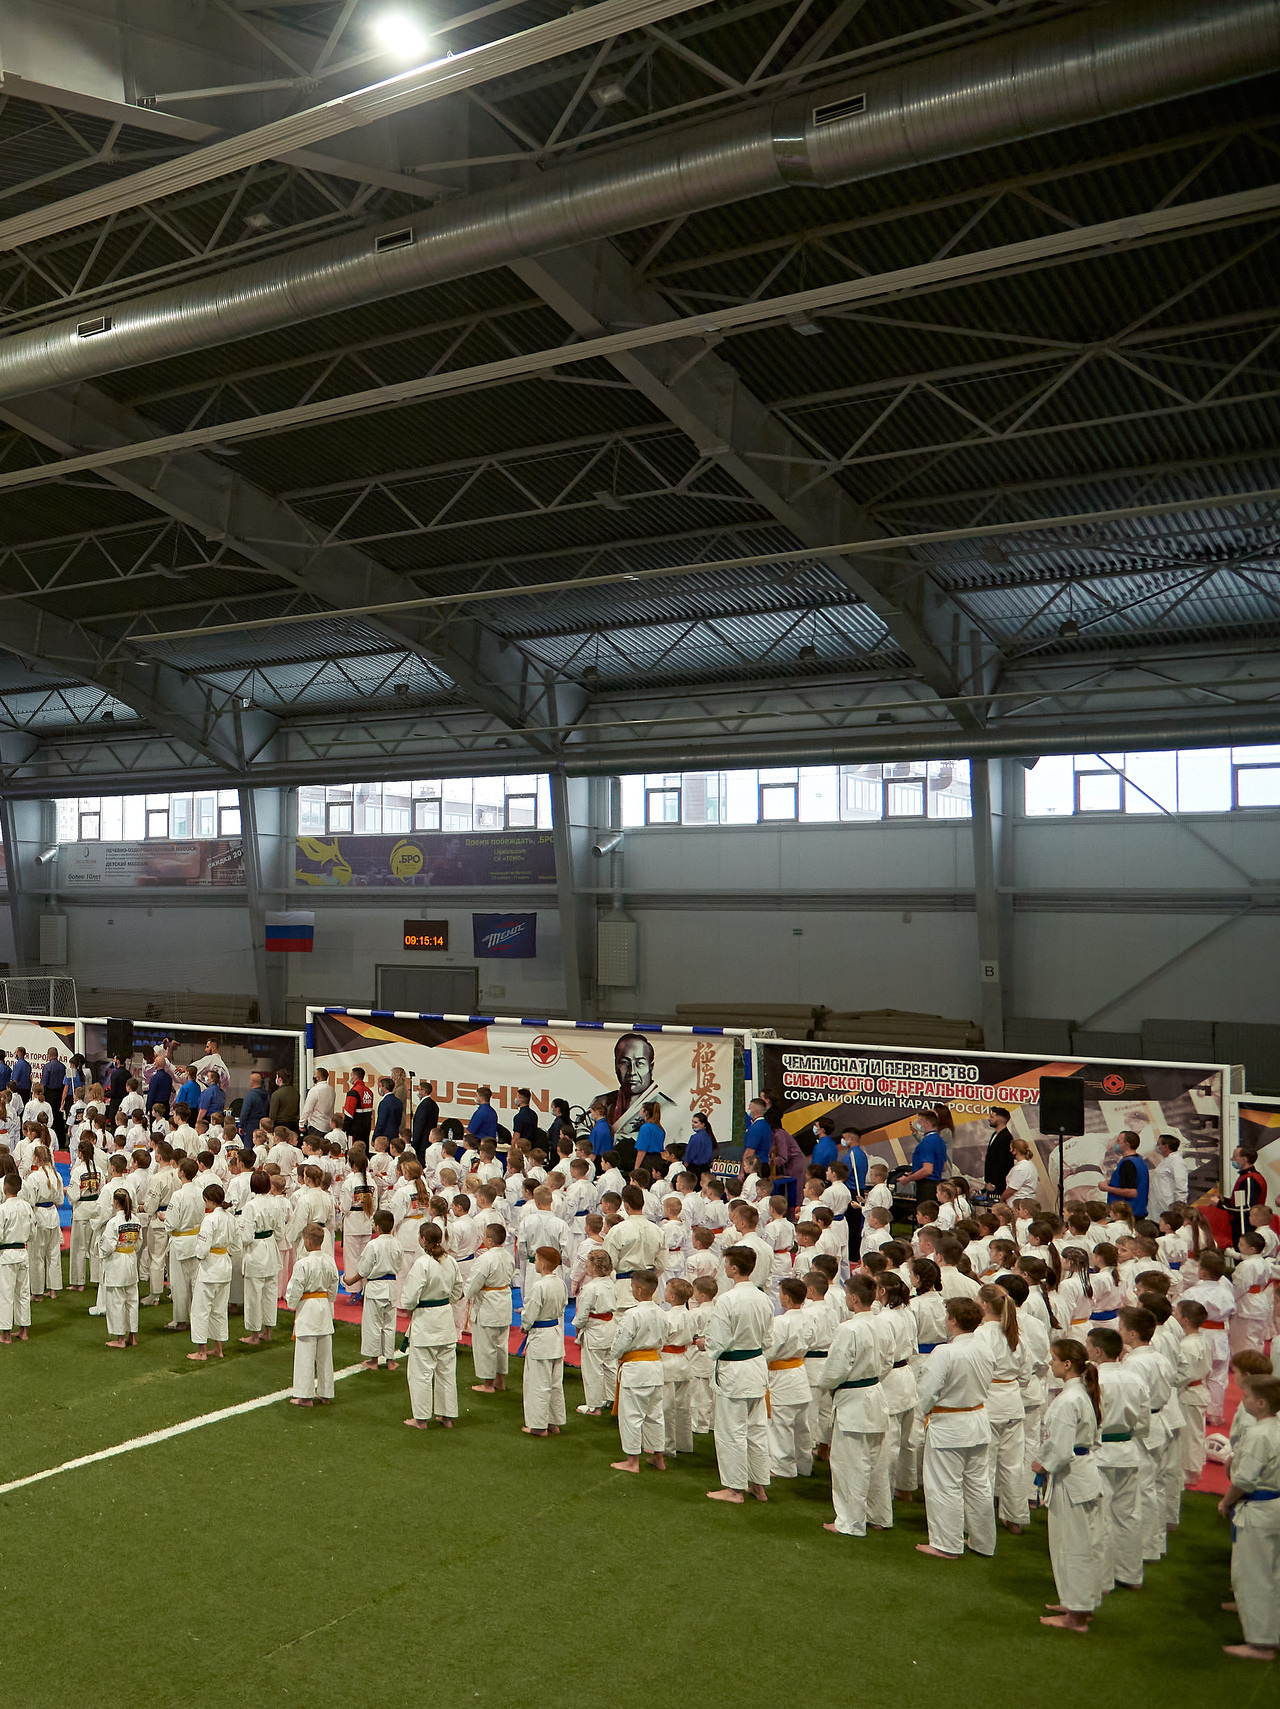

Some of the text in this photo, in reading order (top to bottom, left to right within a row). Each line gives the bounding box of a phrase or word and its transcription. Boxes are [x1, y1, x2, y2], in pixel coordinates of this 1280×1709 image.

[465, 838, 489, 847] Время
[404, 935, 444, 946] 09:15:14
[783, 1054, 979, 1082] ЧЕМПИОНАТ И ПЕРВЕНСТВО
[783, 1072, 1040, 1105] СИБИРСКОГО ФЕДЕРАЛЬНОГО ОКРУ
[784, 1090, 825, 1102] СОЮЗА
[827, 1093, 896, 1108] КИОКУШИН
[948, 1102, 993, 1115] РОССИ
